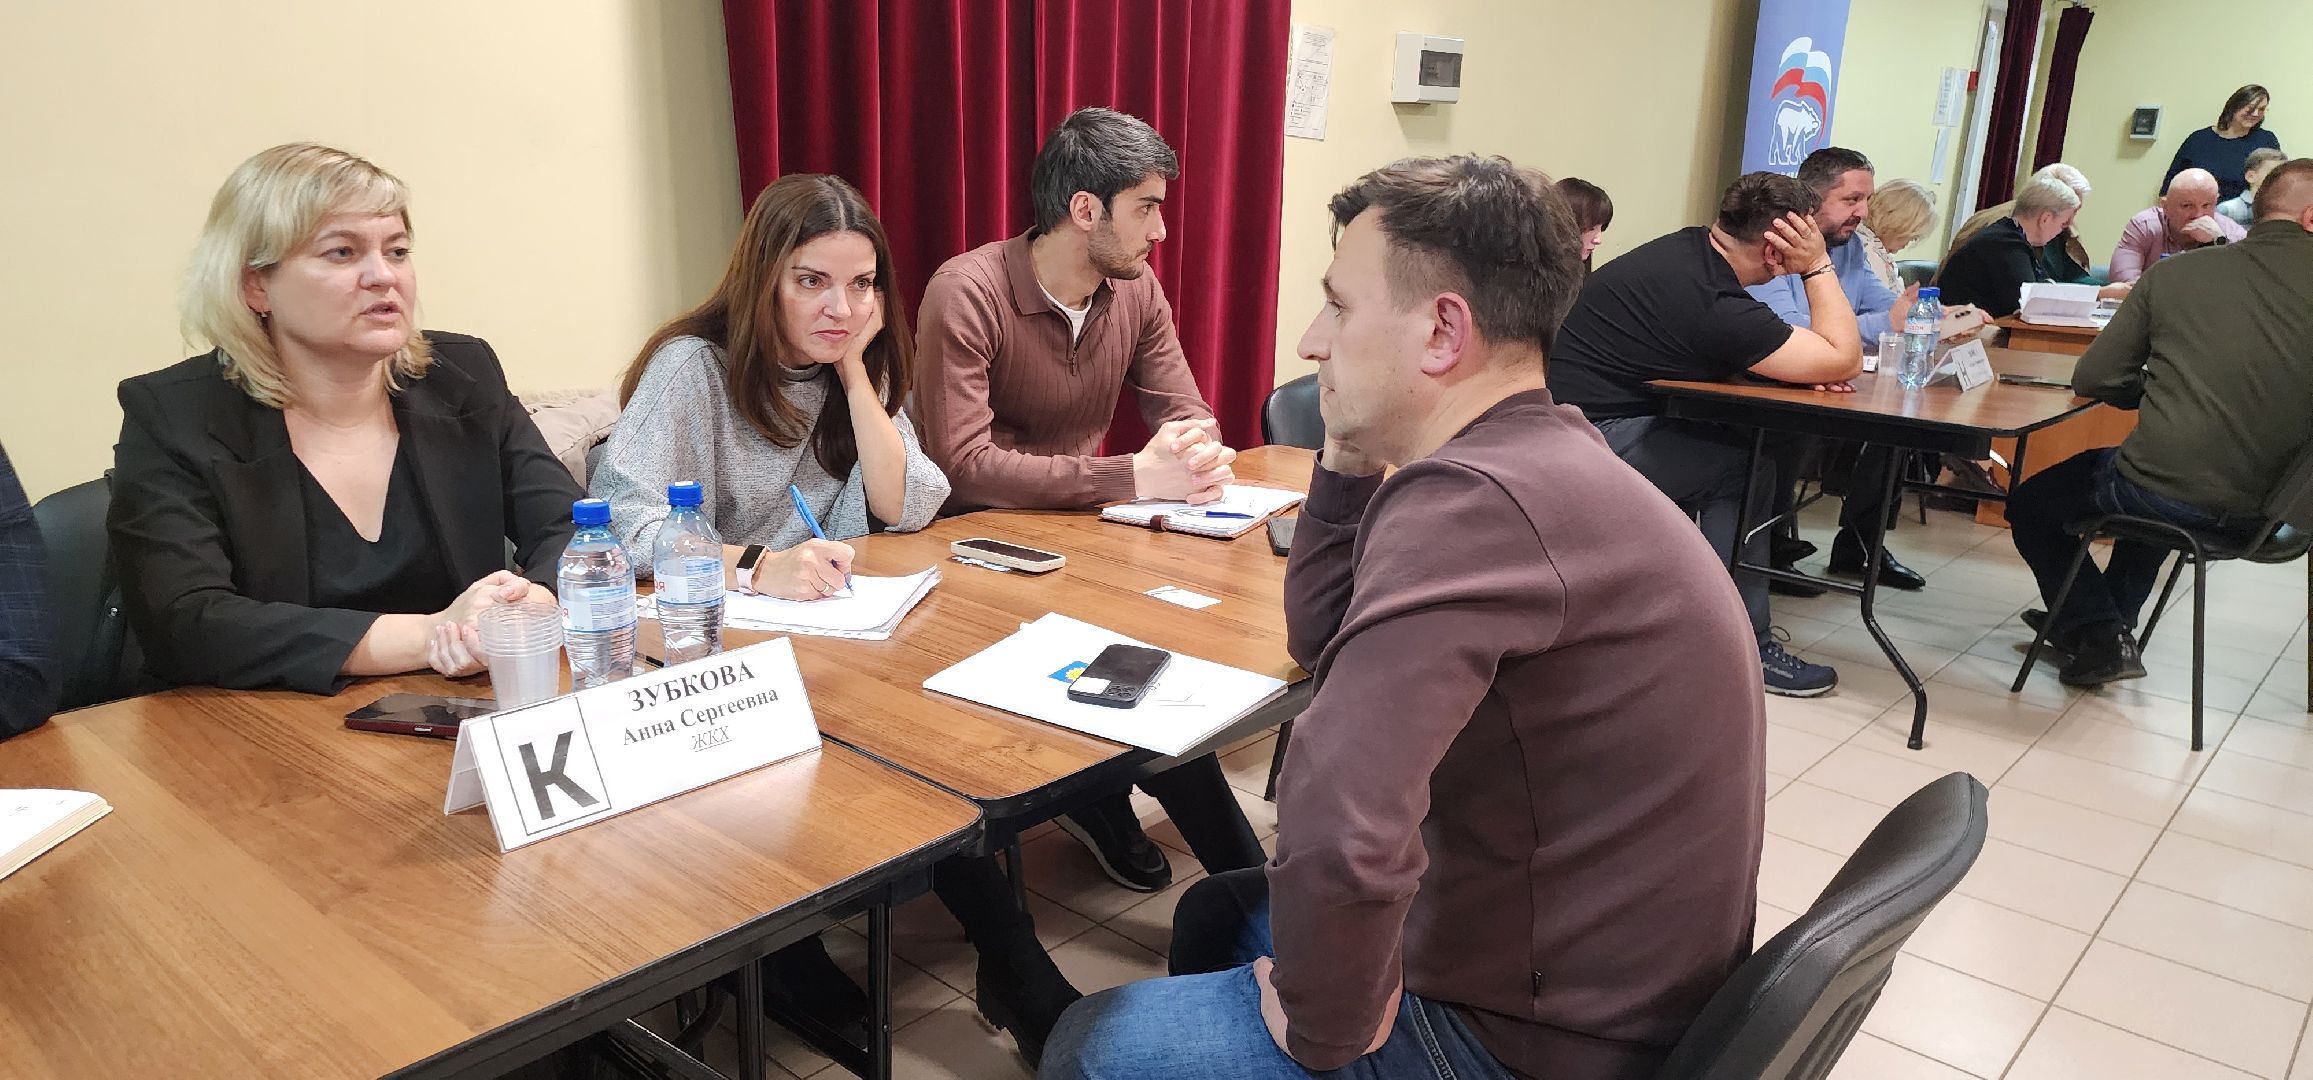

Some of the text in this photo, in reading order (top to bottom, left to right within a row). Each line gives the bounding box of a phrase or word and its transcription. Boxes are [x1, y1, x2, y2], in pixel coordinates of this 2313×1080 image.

[627, 660, 755, 711] ЗУБКОВА
[623, 689, 779, 746] Анна Сергеевна
[691, 725, 731, 751] ЖКХ
[518, 730, 600, 821] К
